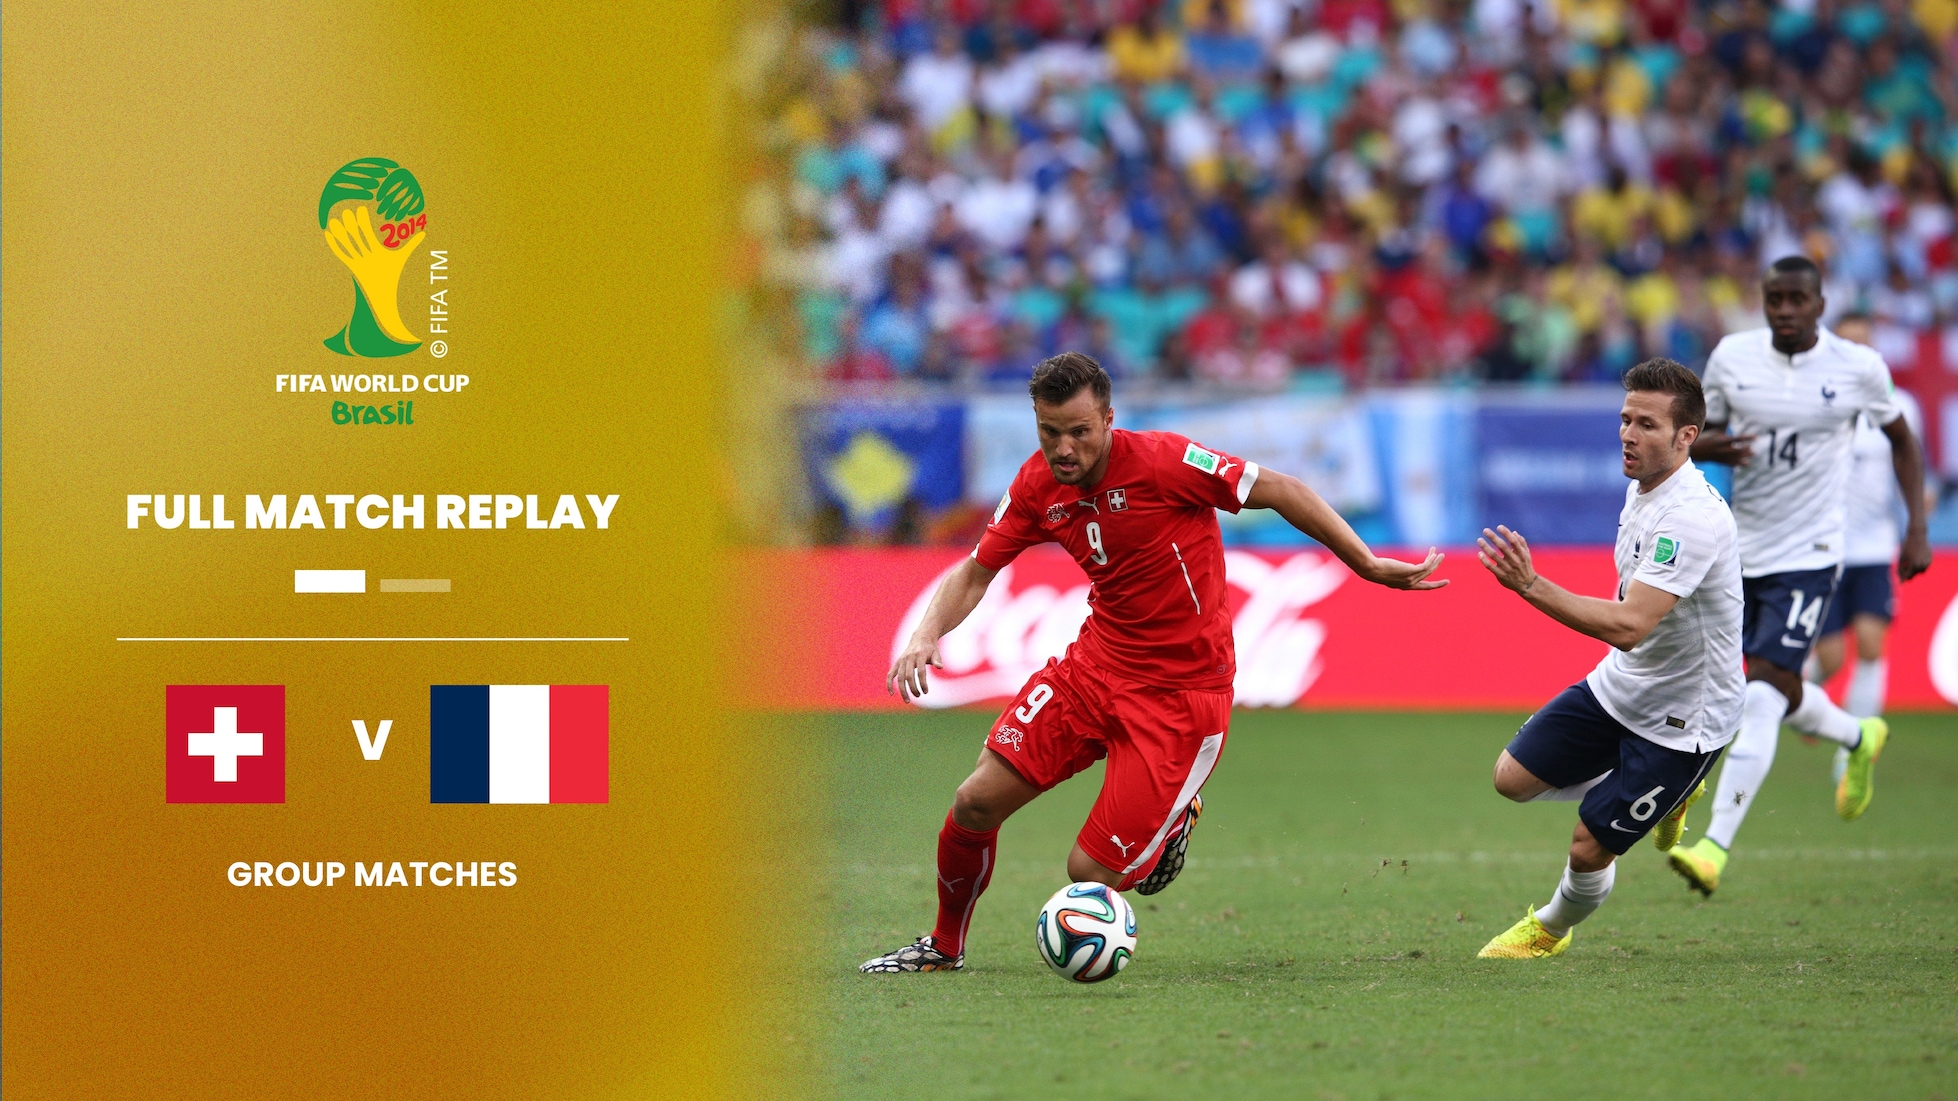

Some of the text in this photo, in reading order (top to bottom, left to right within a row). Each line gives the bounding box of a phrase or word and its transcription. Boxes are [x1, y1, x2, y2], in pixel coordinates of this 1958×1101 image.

[1767, 429, 1799, 470] 14
[1085, 521, 1108, 566] 9
[1786, 588, 1823, 638] 14
[1014, 682, 1055, 725] 9
[1629, 784, 1666, 822] 6
